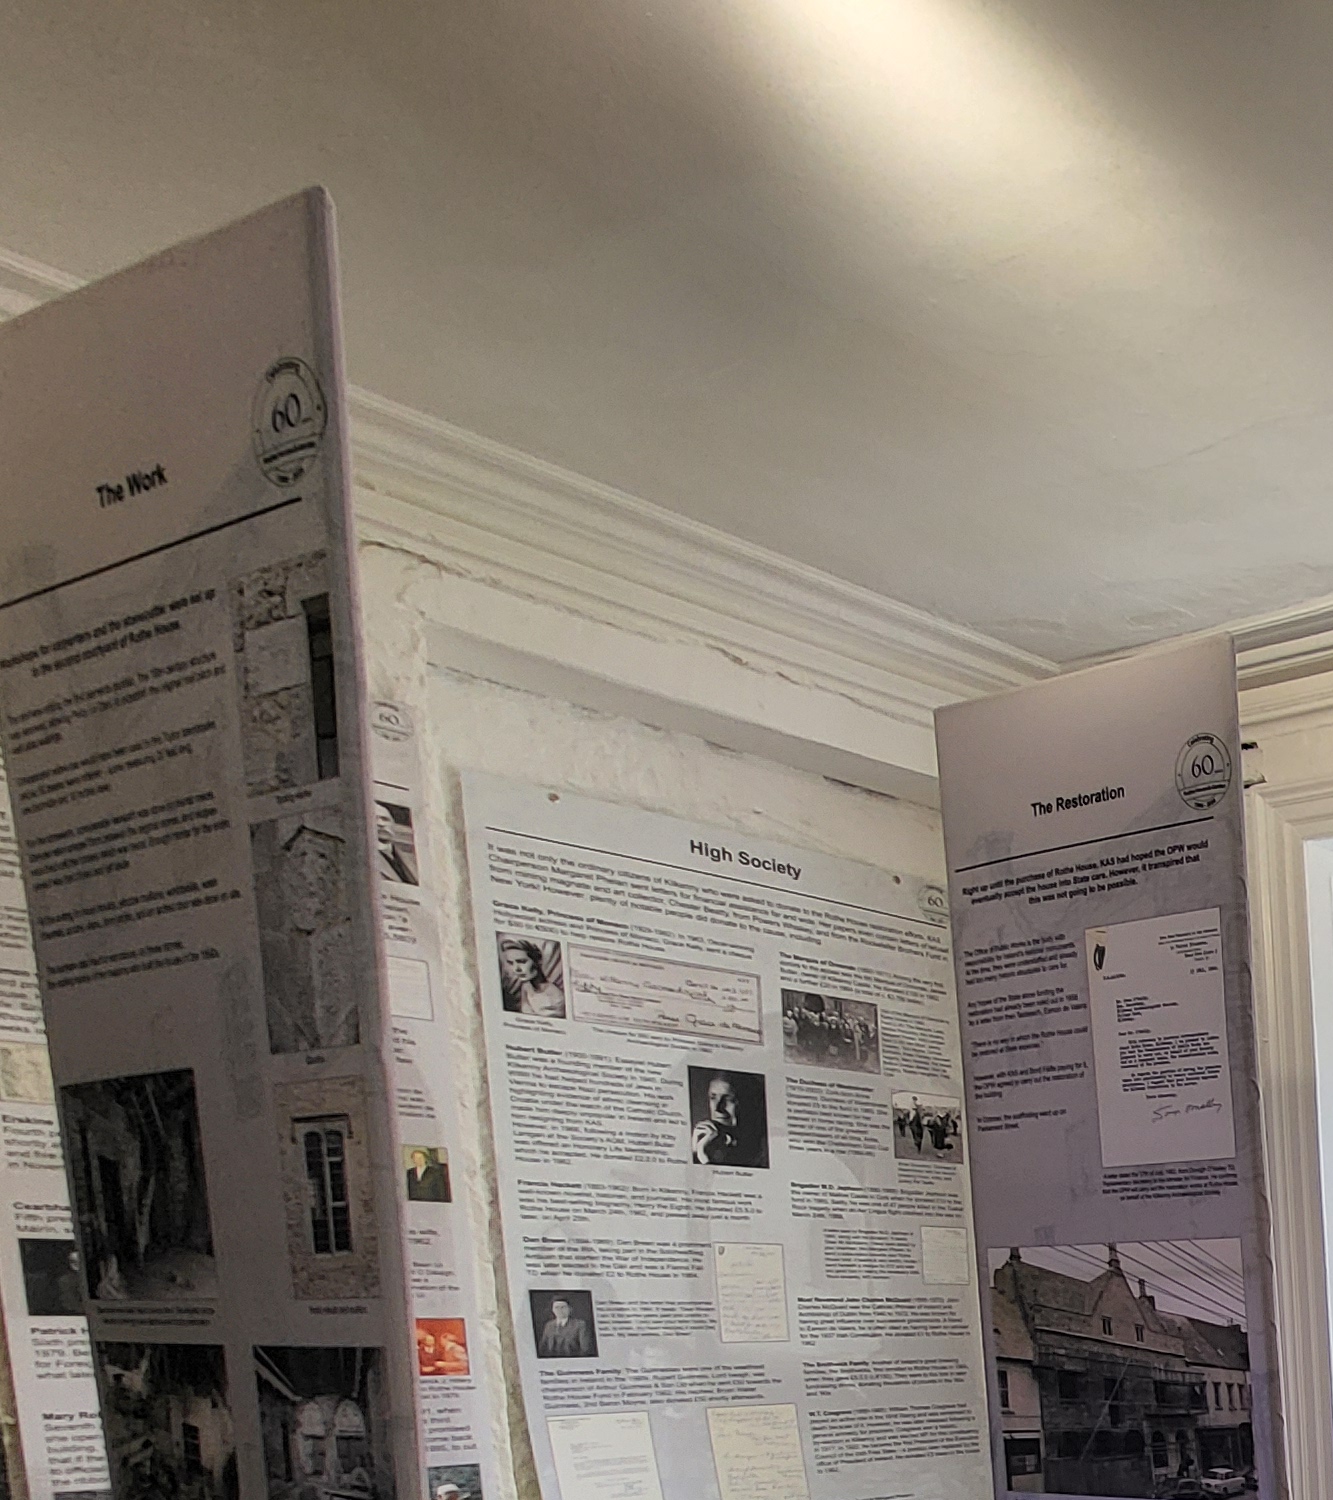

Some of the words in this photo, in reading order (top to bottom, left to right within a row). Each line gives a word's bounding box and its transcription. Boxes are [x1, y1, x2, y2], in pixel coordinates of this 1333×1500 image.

[96, 482, 124, 509] The
[126, 462, 169, 500] Work
[1192, 755, 1214, 778] 60
[1031, 800, 1053, 817] The
[1056, 784, 1125, 812] Restoration
[689, 839, 733, 862] High
[738, 848, 802, 881] Society
[42, 1412, 74, 1421] Mary
